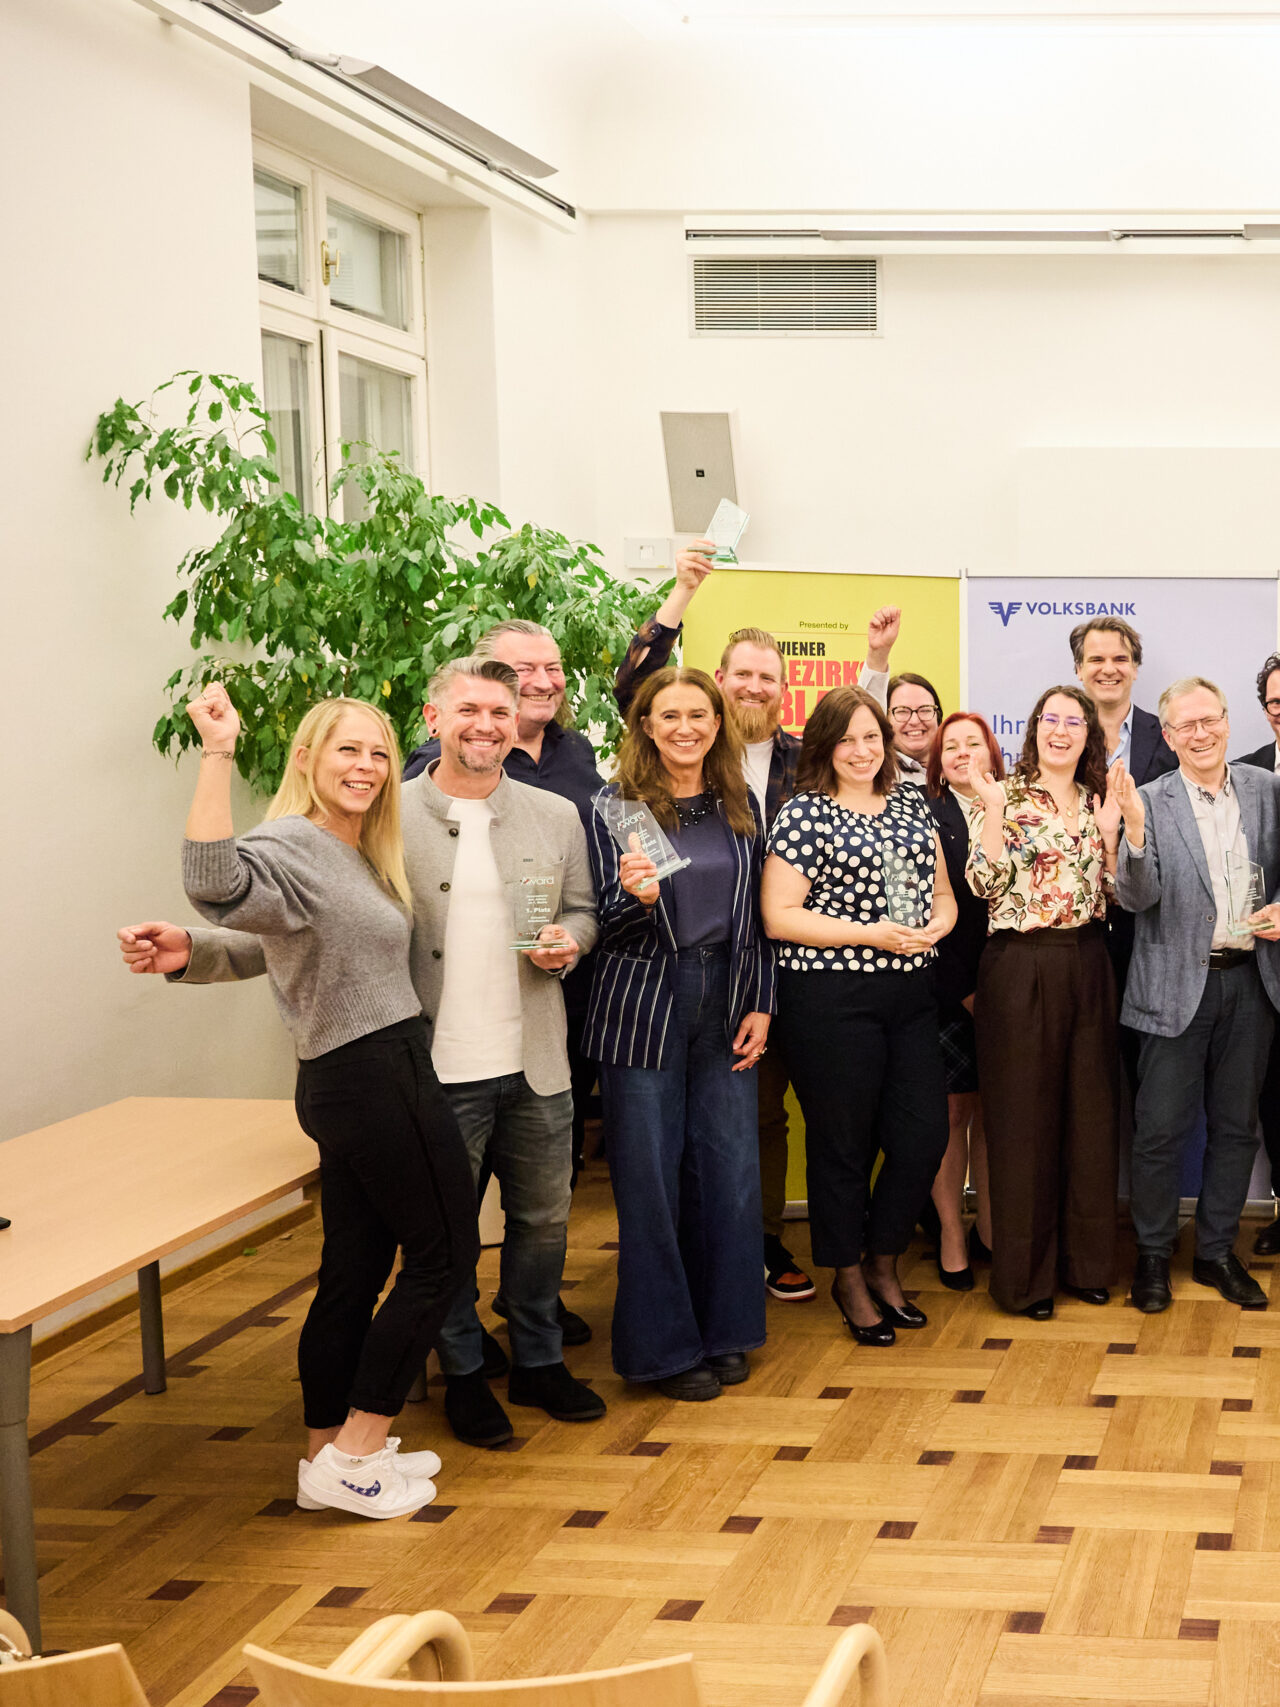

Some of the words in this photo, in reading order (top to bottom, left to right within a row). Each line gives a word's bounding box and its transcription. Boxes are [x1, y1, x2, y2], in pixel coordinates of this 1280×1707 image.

[1025, 601, 1137, 616] VOLKSBANK
[799, 621, 838, 629] Presented
[839, 622, 849, 630] by
[788, 659, 865, 687] EZIRK
[781, 689, 828, 727] BL
[993, 714, 1026, 735] Ihr
